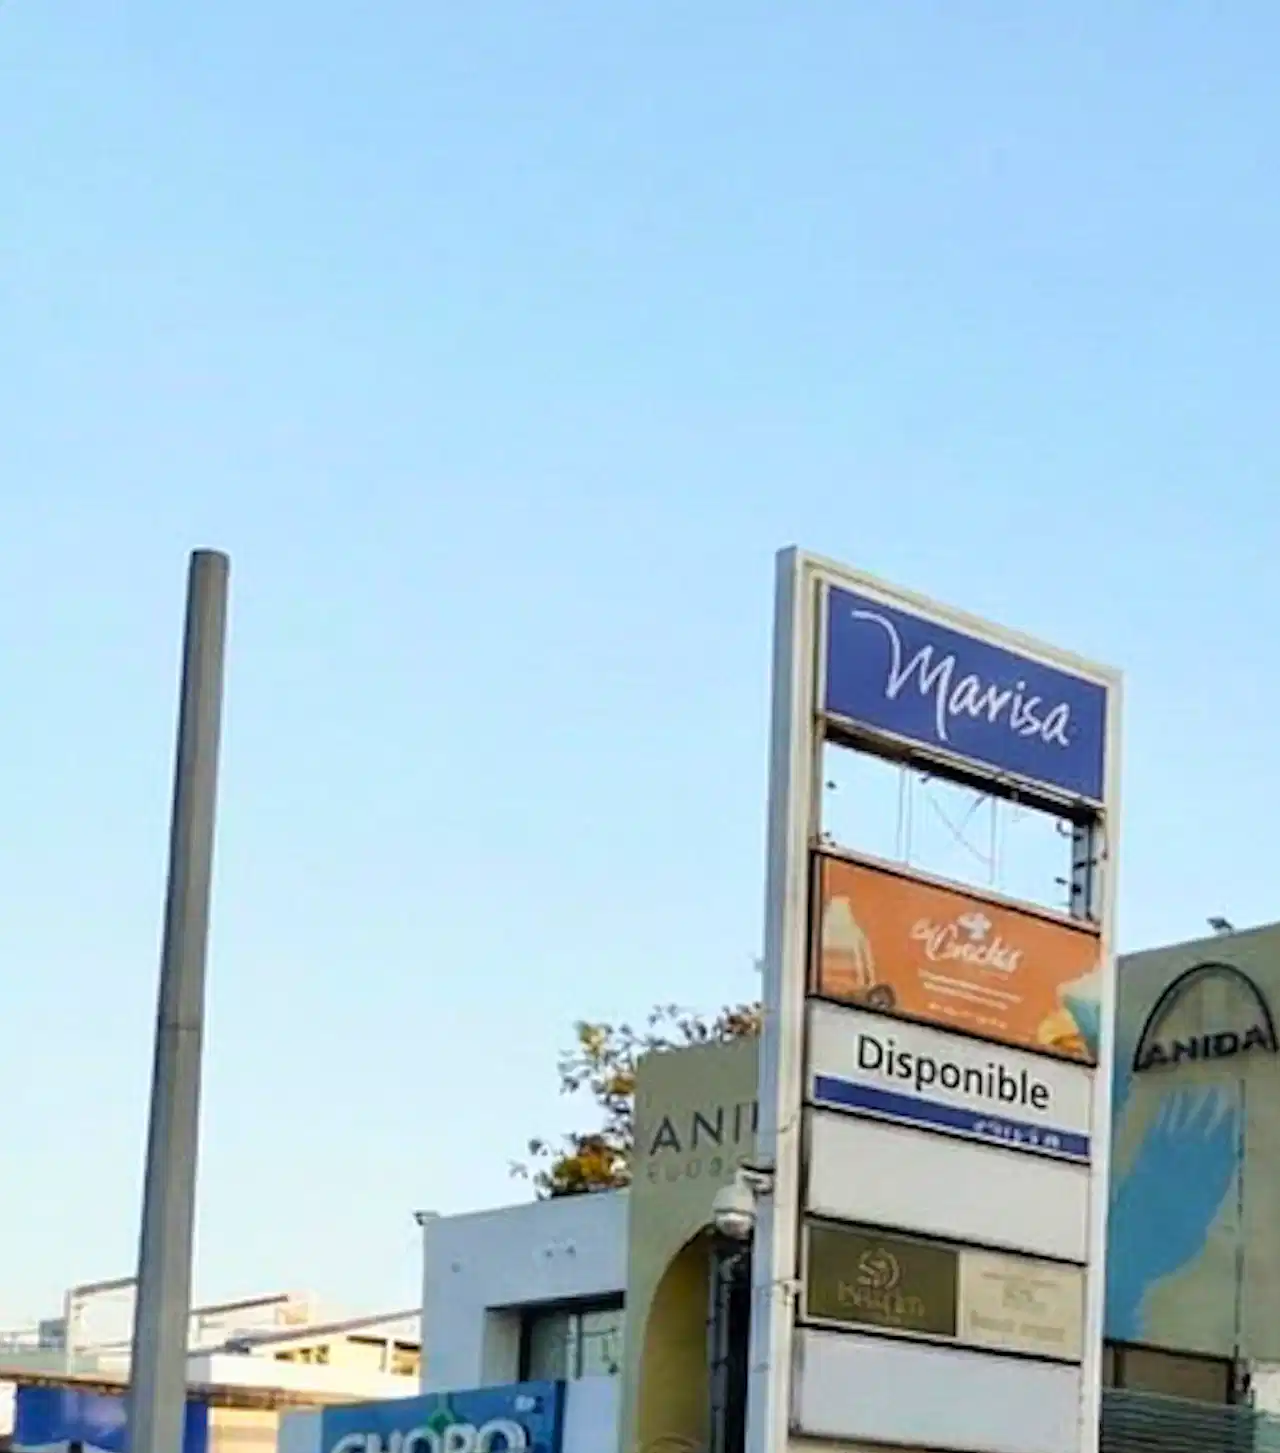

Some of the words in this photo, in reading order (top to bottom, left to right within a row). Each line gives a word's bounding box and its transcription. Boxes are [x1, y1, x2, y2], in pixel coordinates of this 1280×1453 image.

[851, 609, 1070, 747] Marisa
[858, 1034, 1050, 1109] Disponible
[1143, 1024, 1269, 1069] ANIDA
